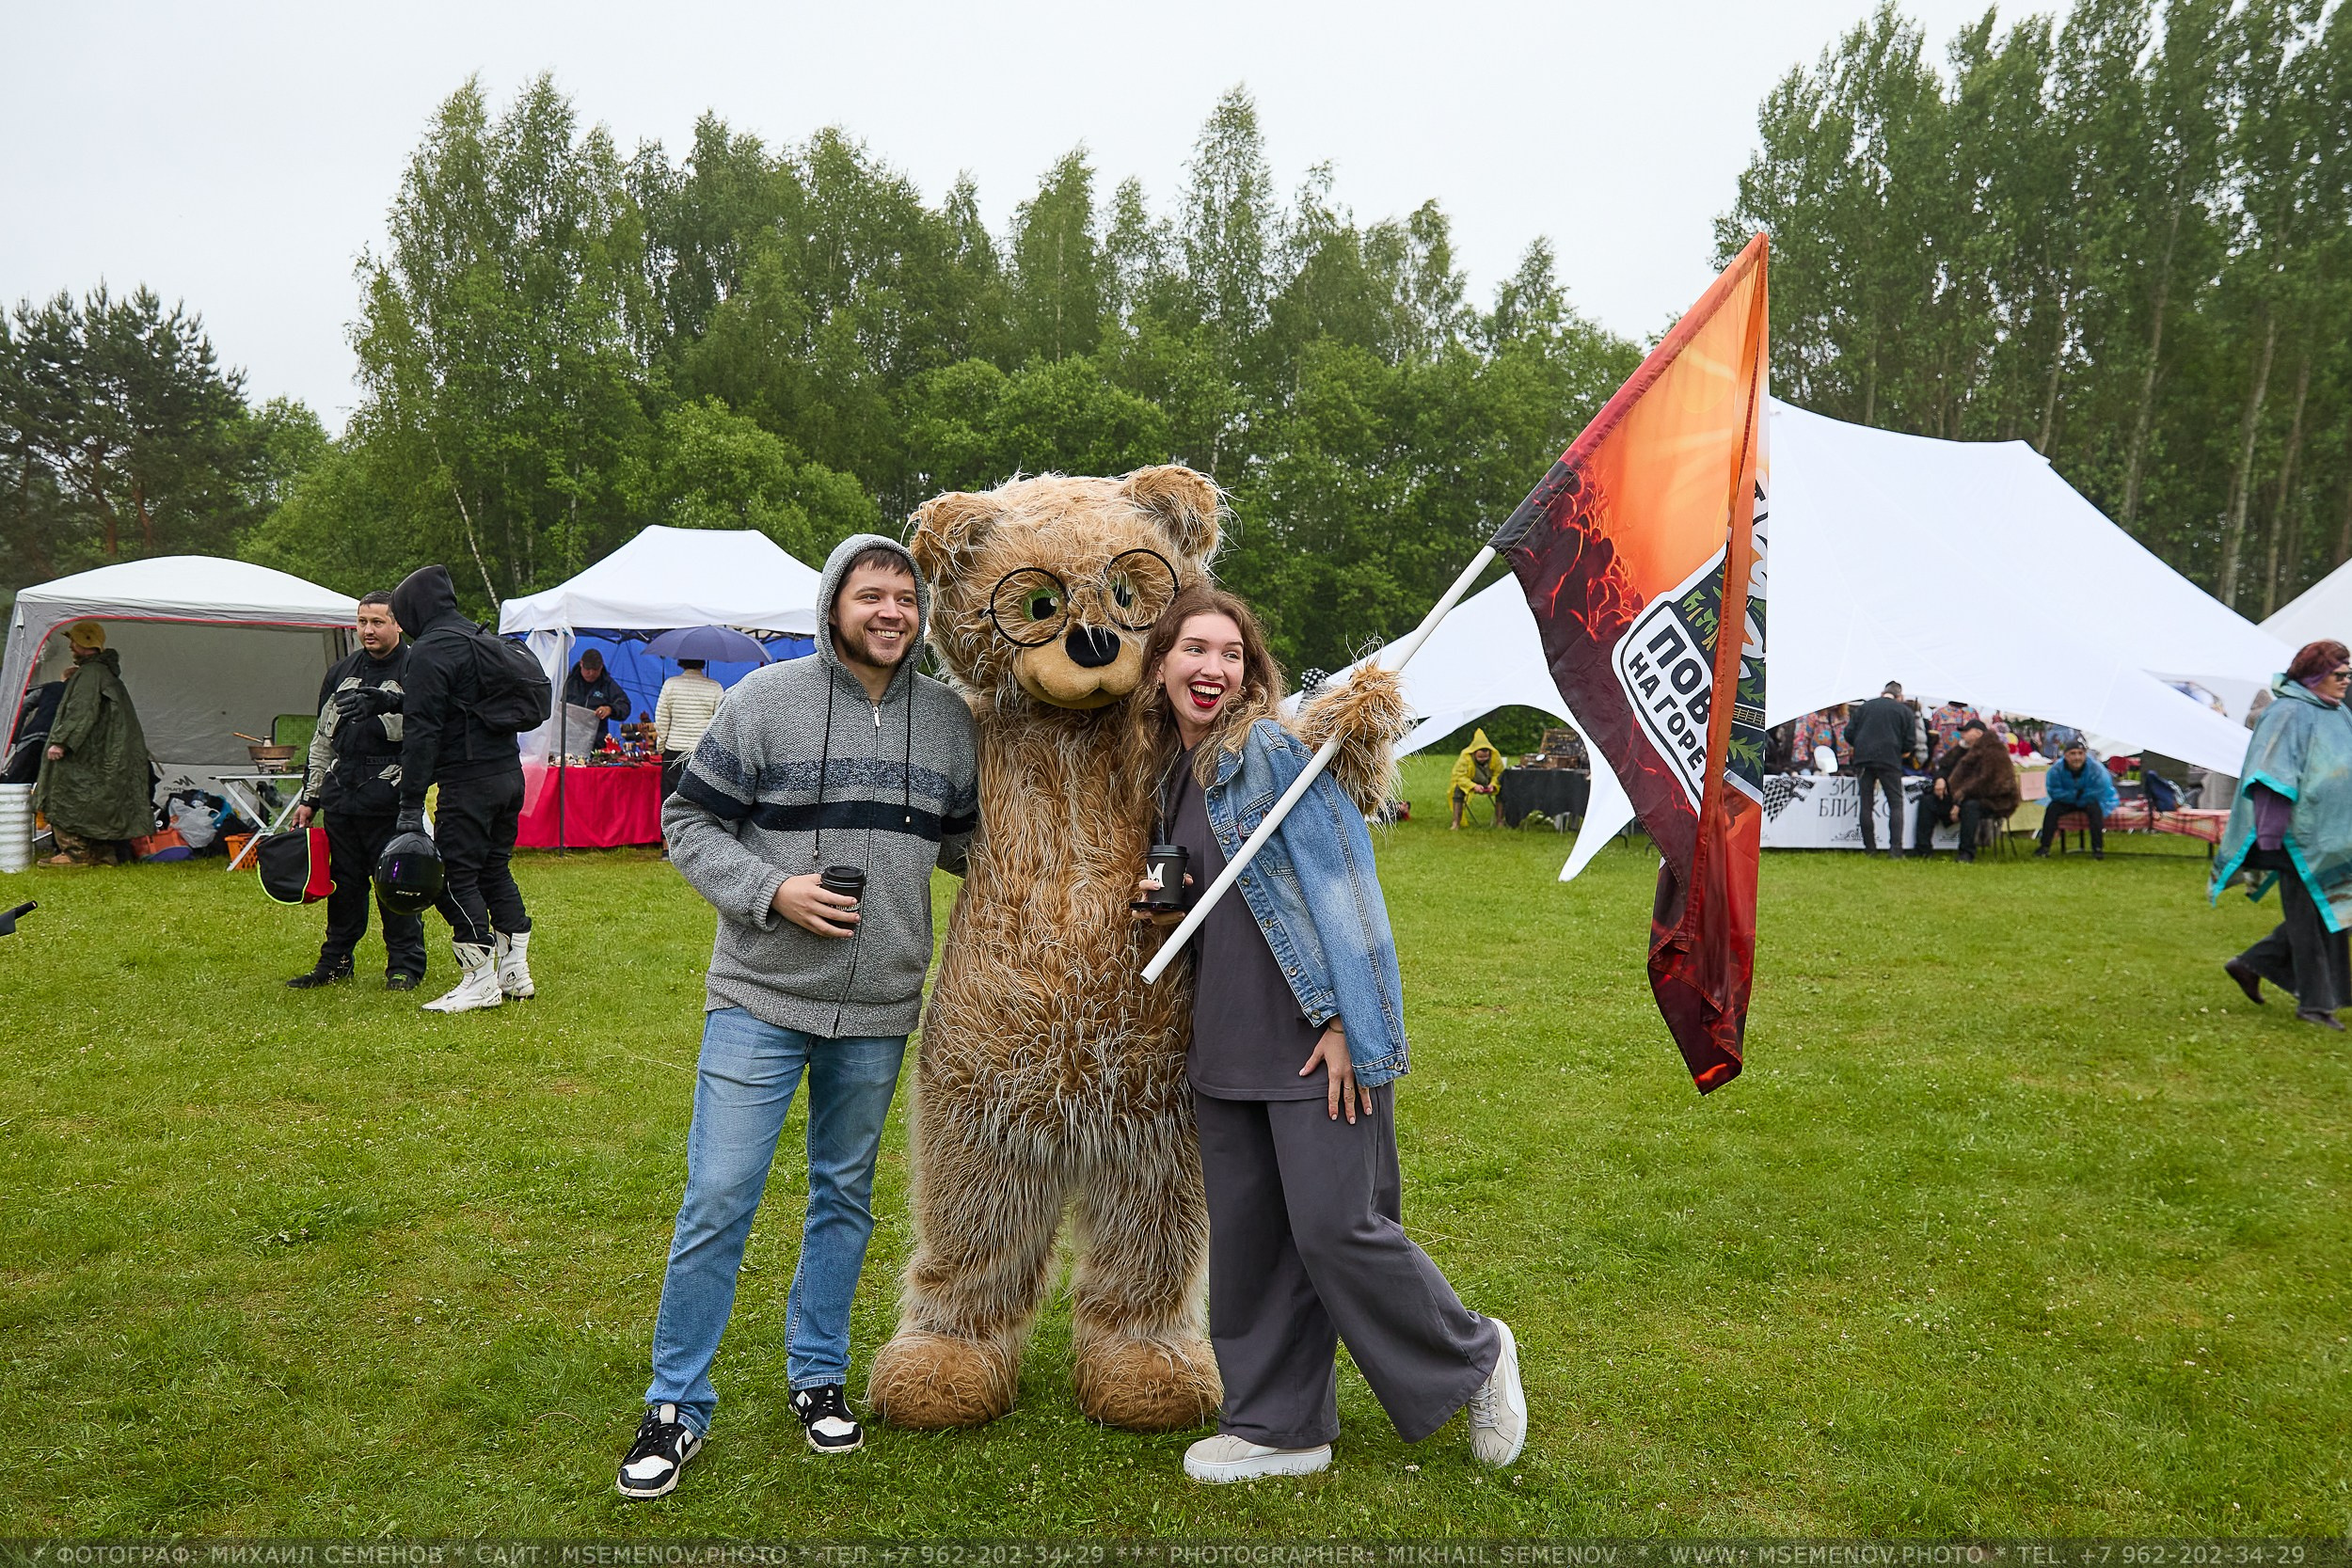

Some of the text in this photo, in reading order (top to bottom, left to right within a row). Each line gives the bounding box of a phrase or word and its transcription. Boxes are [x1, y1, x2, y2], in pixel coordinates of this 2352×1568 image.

[1628, 651, 1707, 784] НА ГОРЕ
[1646, 624, 1712, 725] ПОВ
